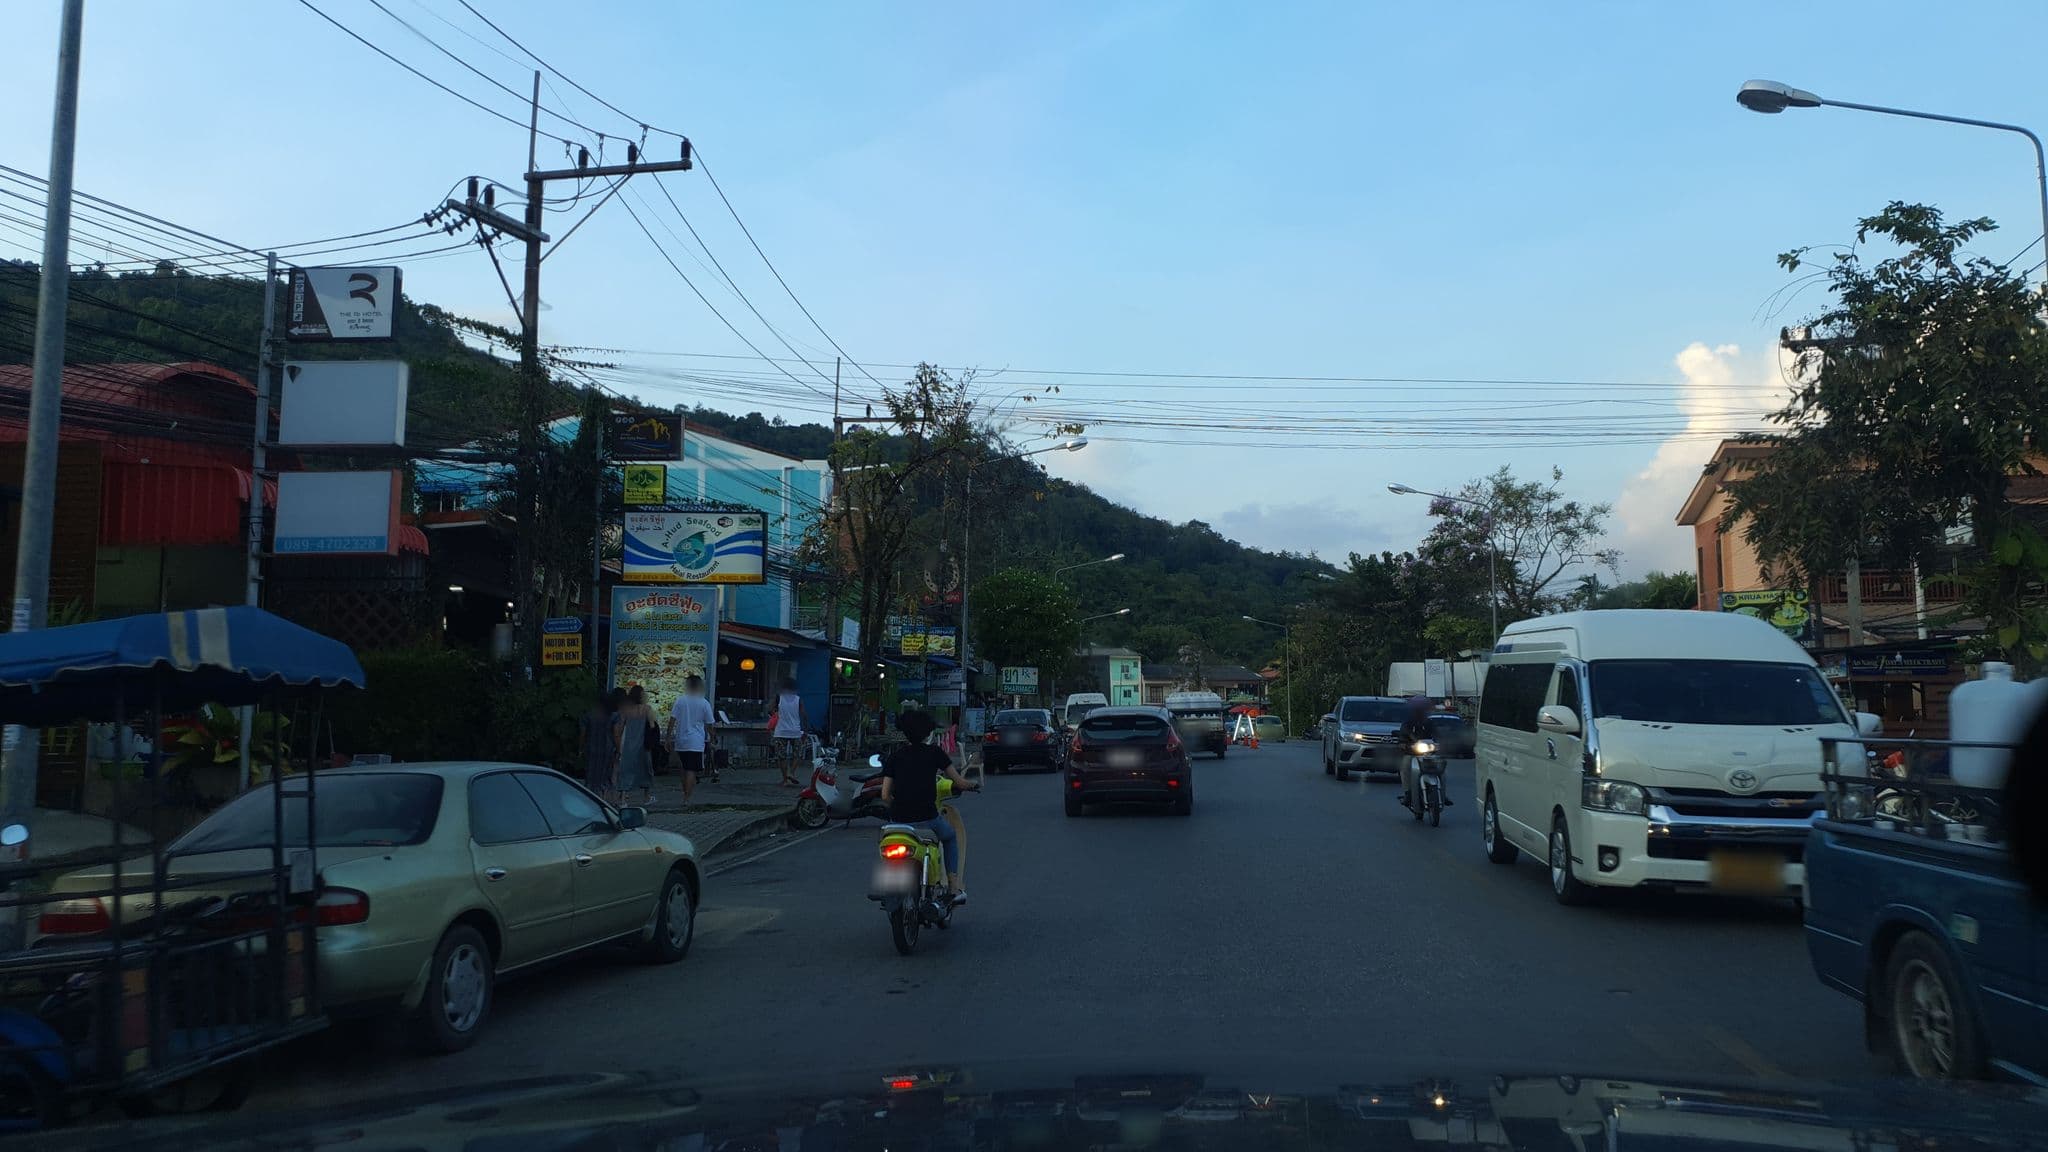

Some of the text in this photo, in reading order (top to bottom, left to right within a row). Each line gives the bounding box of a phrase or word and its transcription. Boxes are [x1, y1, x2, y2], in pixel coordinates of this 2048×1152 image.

[685, 516, 722, 538] Seafood
[686, 559, 721, 580] Restaurant
[544, 638, 565, 648] MOTOR
[552, 651, 579, 662] FOR RENT
[1004, 669, 1018, 683] ยา
[1003, 684, 1037, 693] PHARMACY
